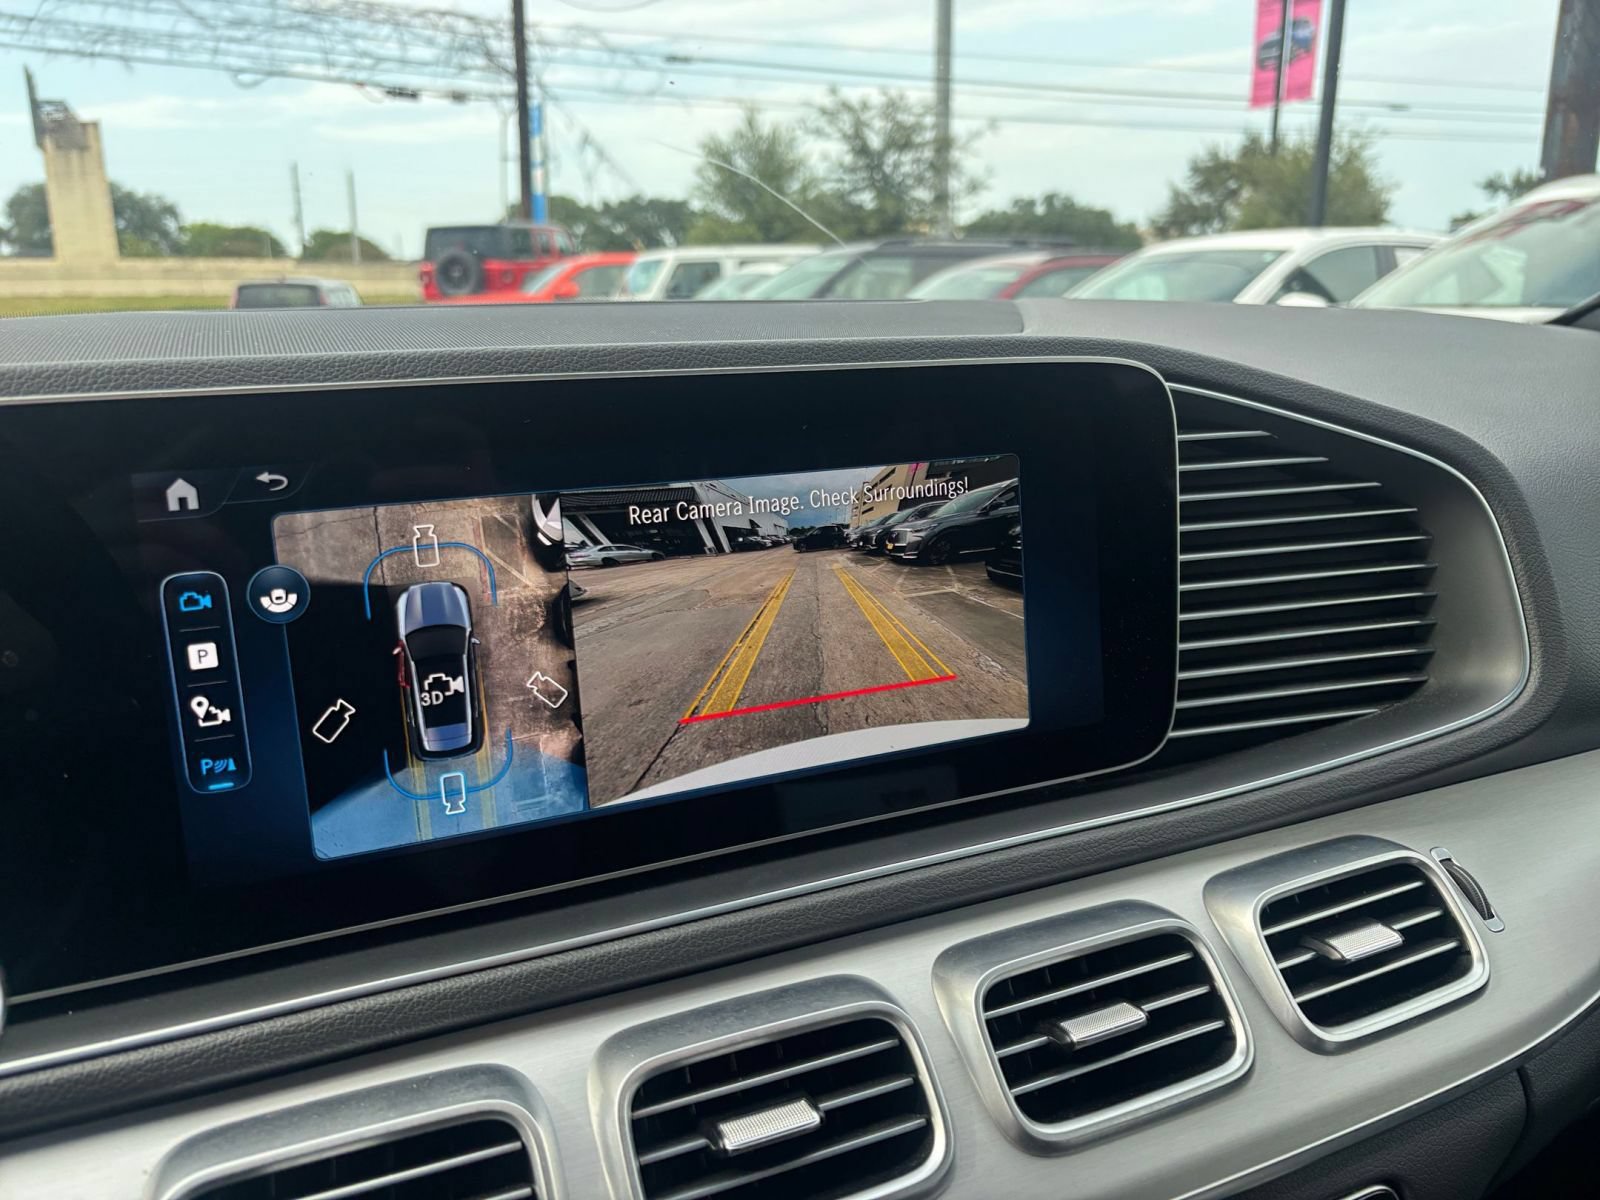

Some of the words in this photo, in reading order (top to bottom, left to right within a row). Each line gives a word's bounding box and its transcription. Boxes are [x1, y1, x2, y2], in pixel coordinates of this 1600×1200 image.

[628, 503, 670, 526] Rear
[675, 498, 743, 521] Camera
[748, 493, 805, 516] Image.
[809, 485, 858, 508] Check
[862, 475, 970, 504] Surroundings!
[197, 649, 209, 665] P
[420, 690, 444, 707] 3D
[200, 758, 214, 775] P
